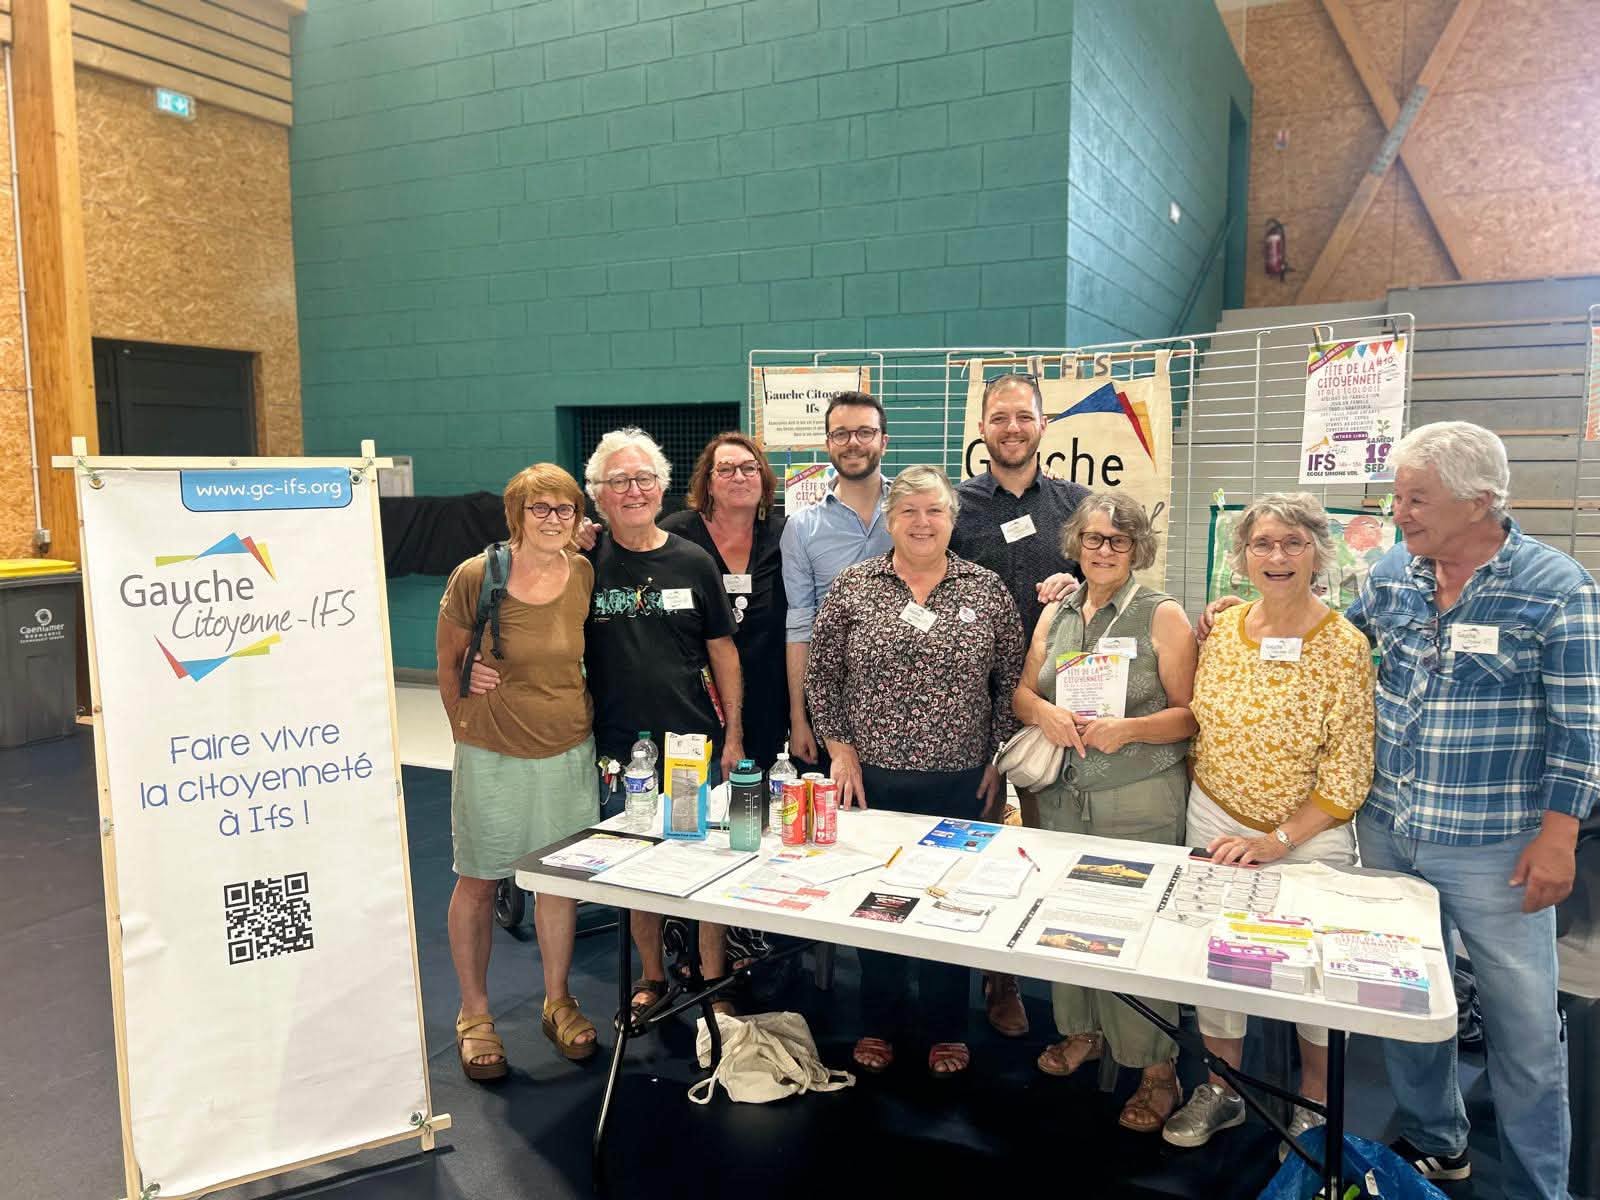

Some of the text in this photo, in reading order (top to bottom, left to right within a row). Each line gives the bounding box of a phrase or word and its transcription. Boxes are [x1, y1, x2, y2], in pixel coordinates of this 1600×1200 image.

[1347, 363, 1358, 374] DE
[1363, 361, 1375, 372] LA
[767, 389, 804, 401] Gauche
[805, 403, 820, 414] Ifs
[1308, 454, 1336, 471] IFS
[1365, 443, 1392, 464] 19
[195, 478, 342, 501] www.gc-ifs.org
[119, 569, 255, 608] Gauche
[170, 723, 341, 764] Faire vivre
[139, 751, 374, 810] la citoyenneté
[218, 808, 241, 837] à
[248, 803, 295, 833] Ifs
